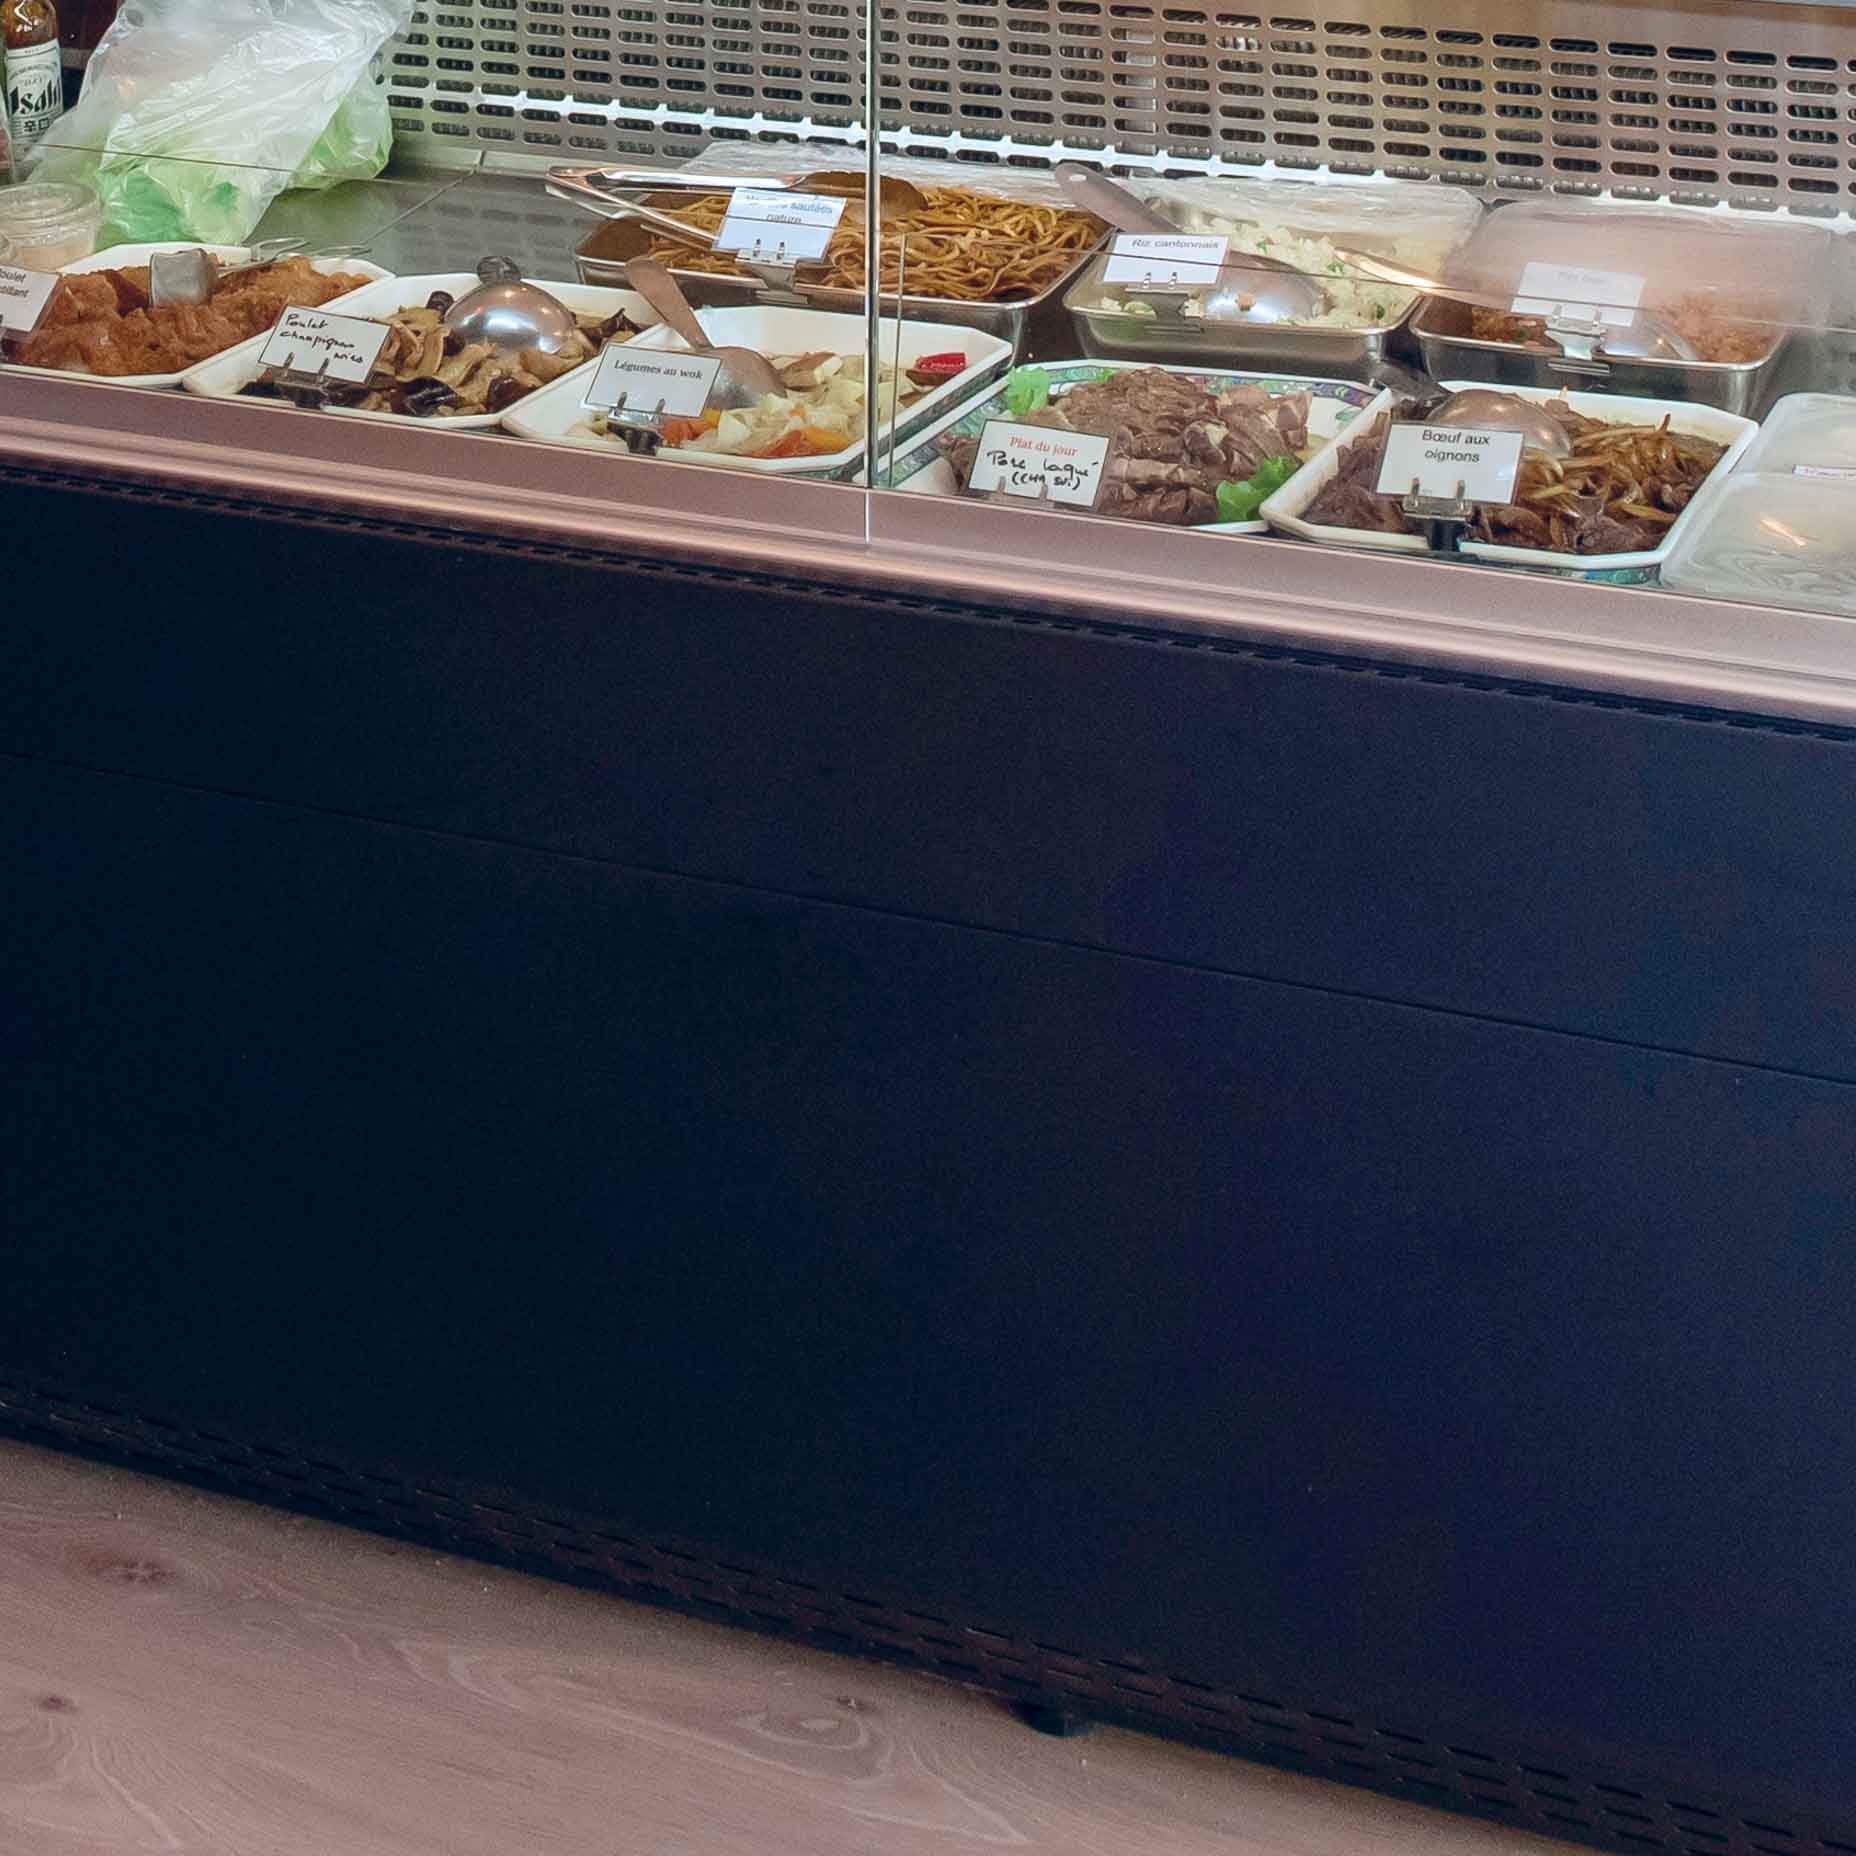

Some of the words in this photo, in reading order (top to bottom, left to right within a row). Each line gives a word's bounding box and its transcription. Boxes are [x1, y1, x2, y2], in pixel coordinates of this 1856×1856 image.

[285, 313, 328, 329] Poulet
[614, 359, 661, 376] Légumes
[663, 366, 678, 376] au
[680, 369, 704, 380] wok
[1009, 436, 1033, 450] Plat
[1036, 441, 1050, 452] du
[1052, 443, 1079, 458] jour
[1464, 434, 1491, 446] aux
[1424, 448, 1481, 464] oignons
